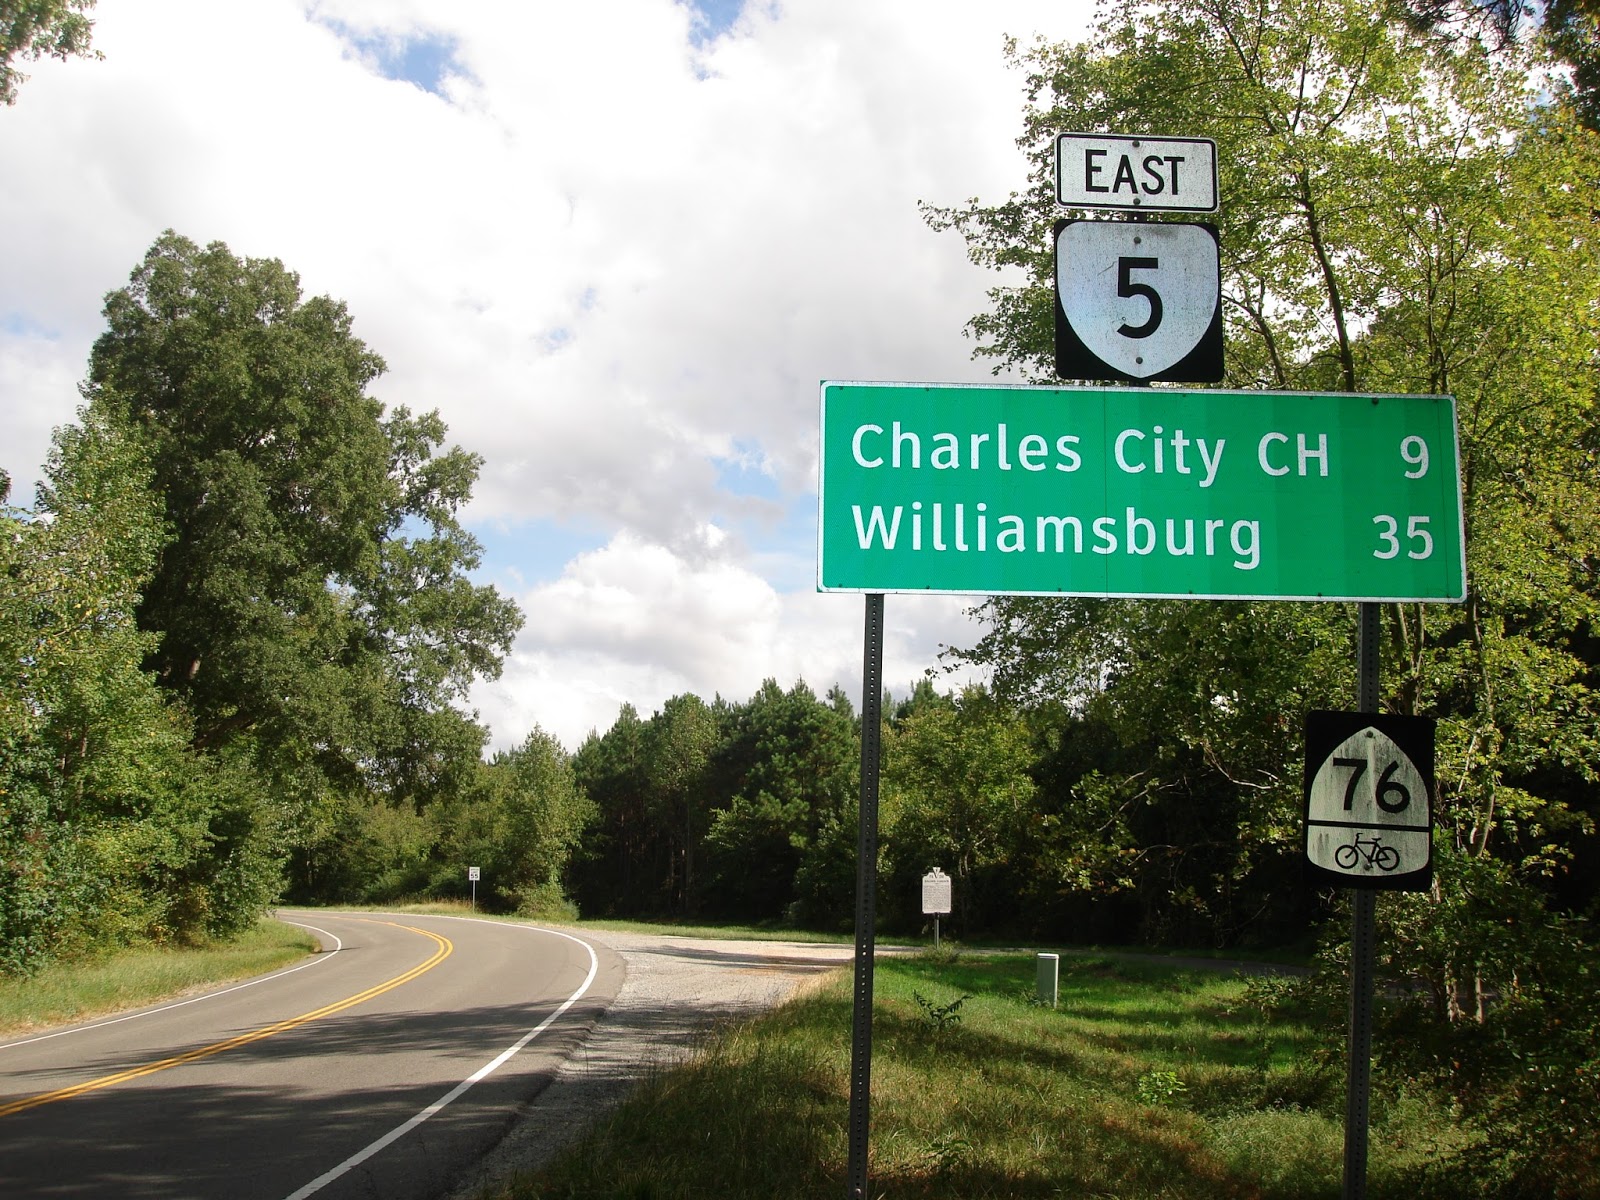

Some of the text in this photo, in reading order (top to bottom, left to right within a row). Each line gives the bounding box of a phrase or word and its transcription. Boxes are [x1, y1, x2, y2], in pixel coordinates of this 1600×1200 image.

[1085, 148, 1185, 196] EAST
[1116, 256, 1164, 339] 5
[851, 421, 1429, 488] Charles City CH 9
[851, 501, 1433, 570] Williamsburg 35
[1332, 757, 1411, 813] 76
